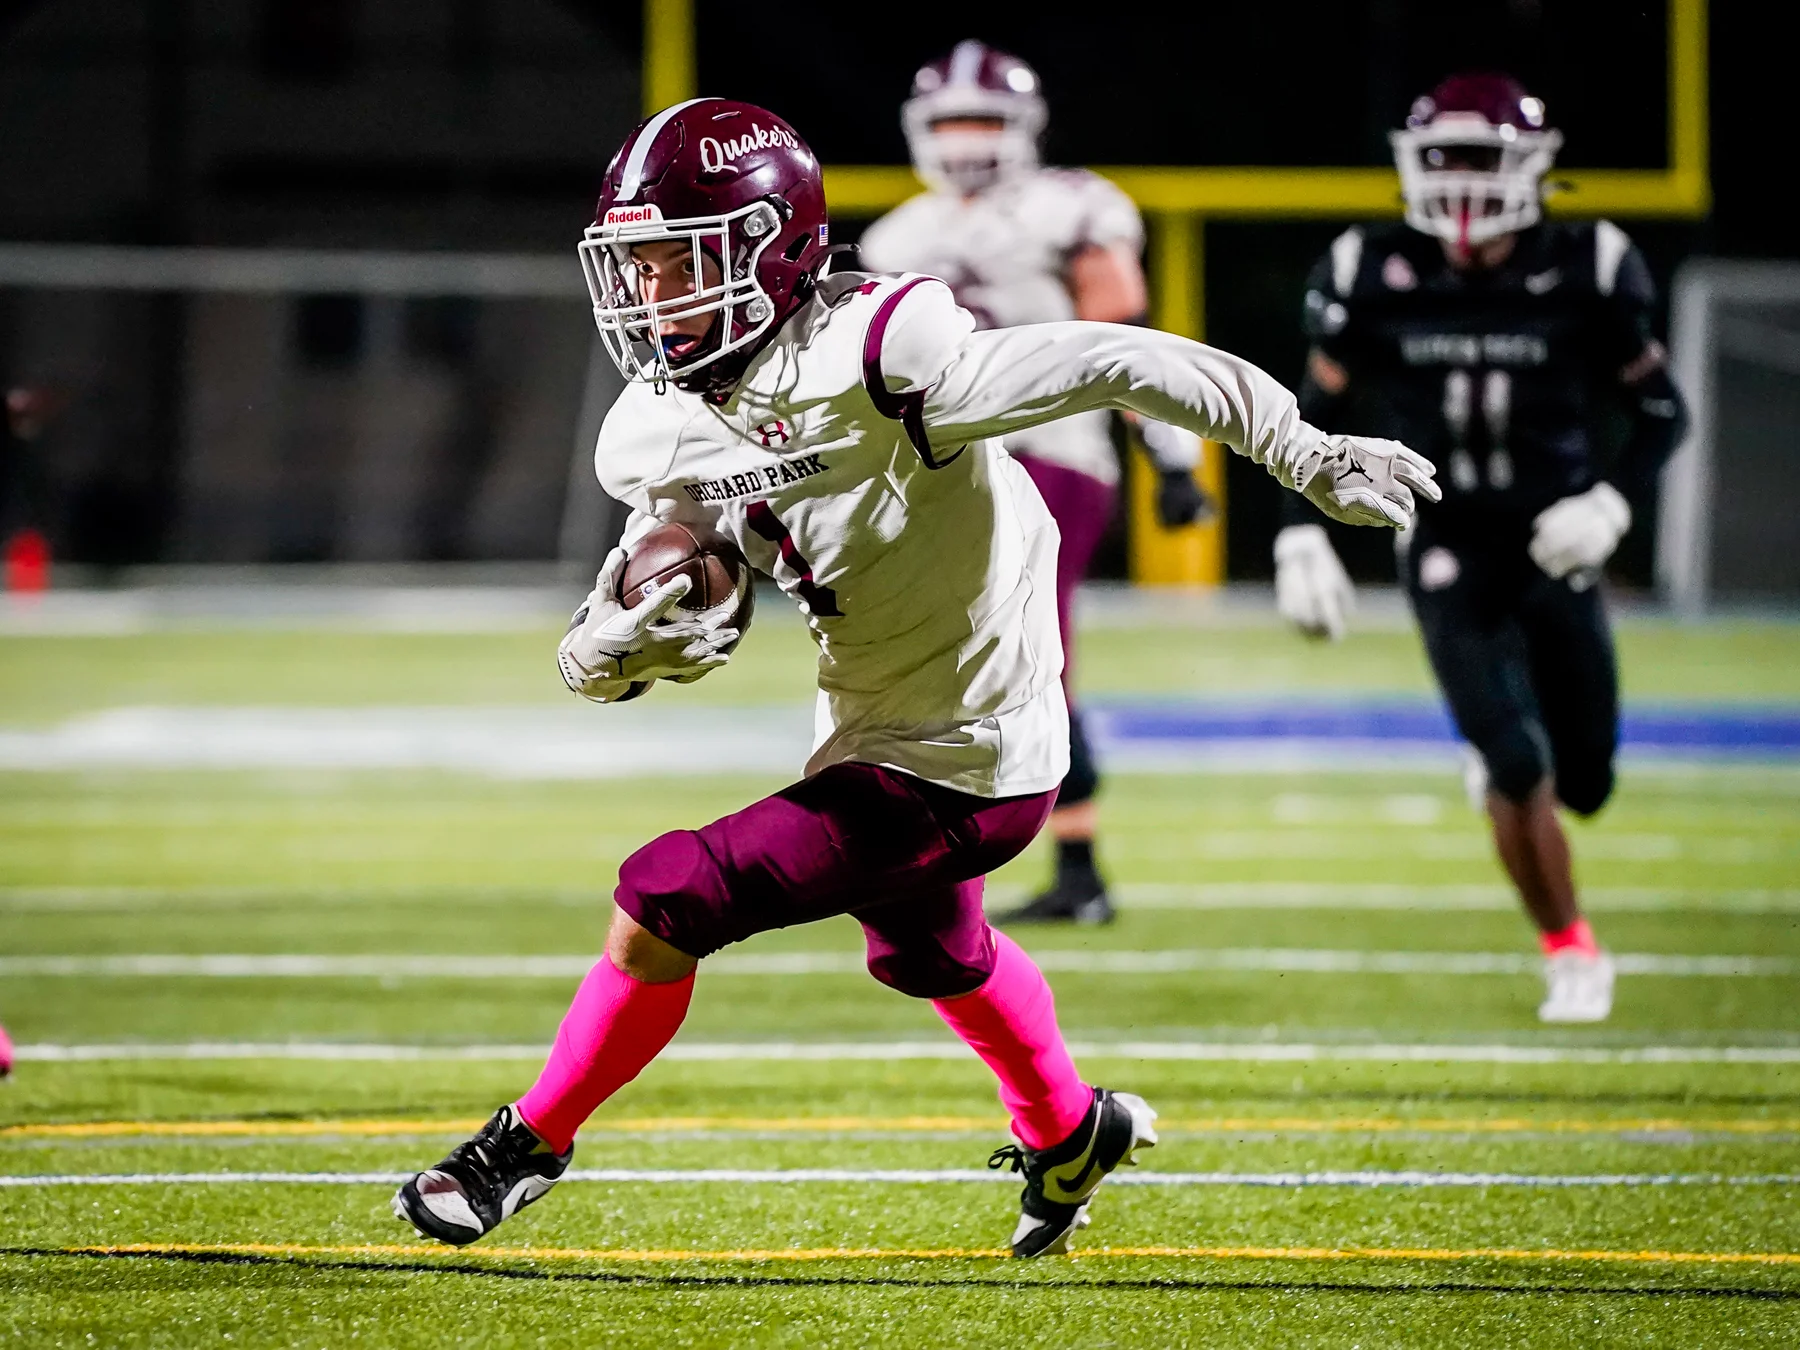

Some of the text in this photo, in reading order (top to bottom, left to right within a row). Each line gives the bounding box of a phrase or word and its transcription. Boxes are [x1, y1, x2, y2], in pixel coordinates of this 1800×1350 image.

[699, 122, 799, 174] Quakers
[607, 207, 652, 224] Riddell
[683, 453, 830, 502] ORCHARD PARK
[746, 499, 846, 617] 1
